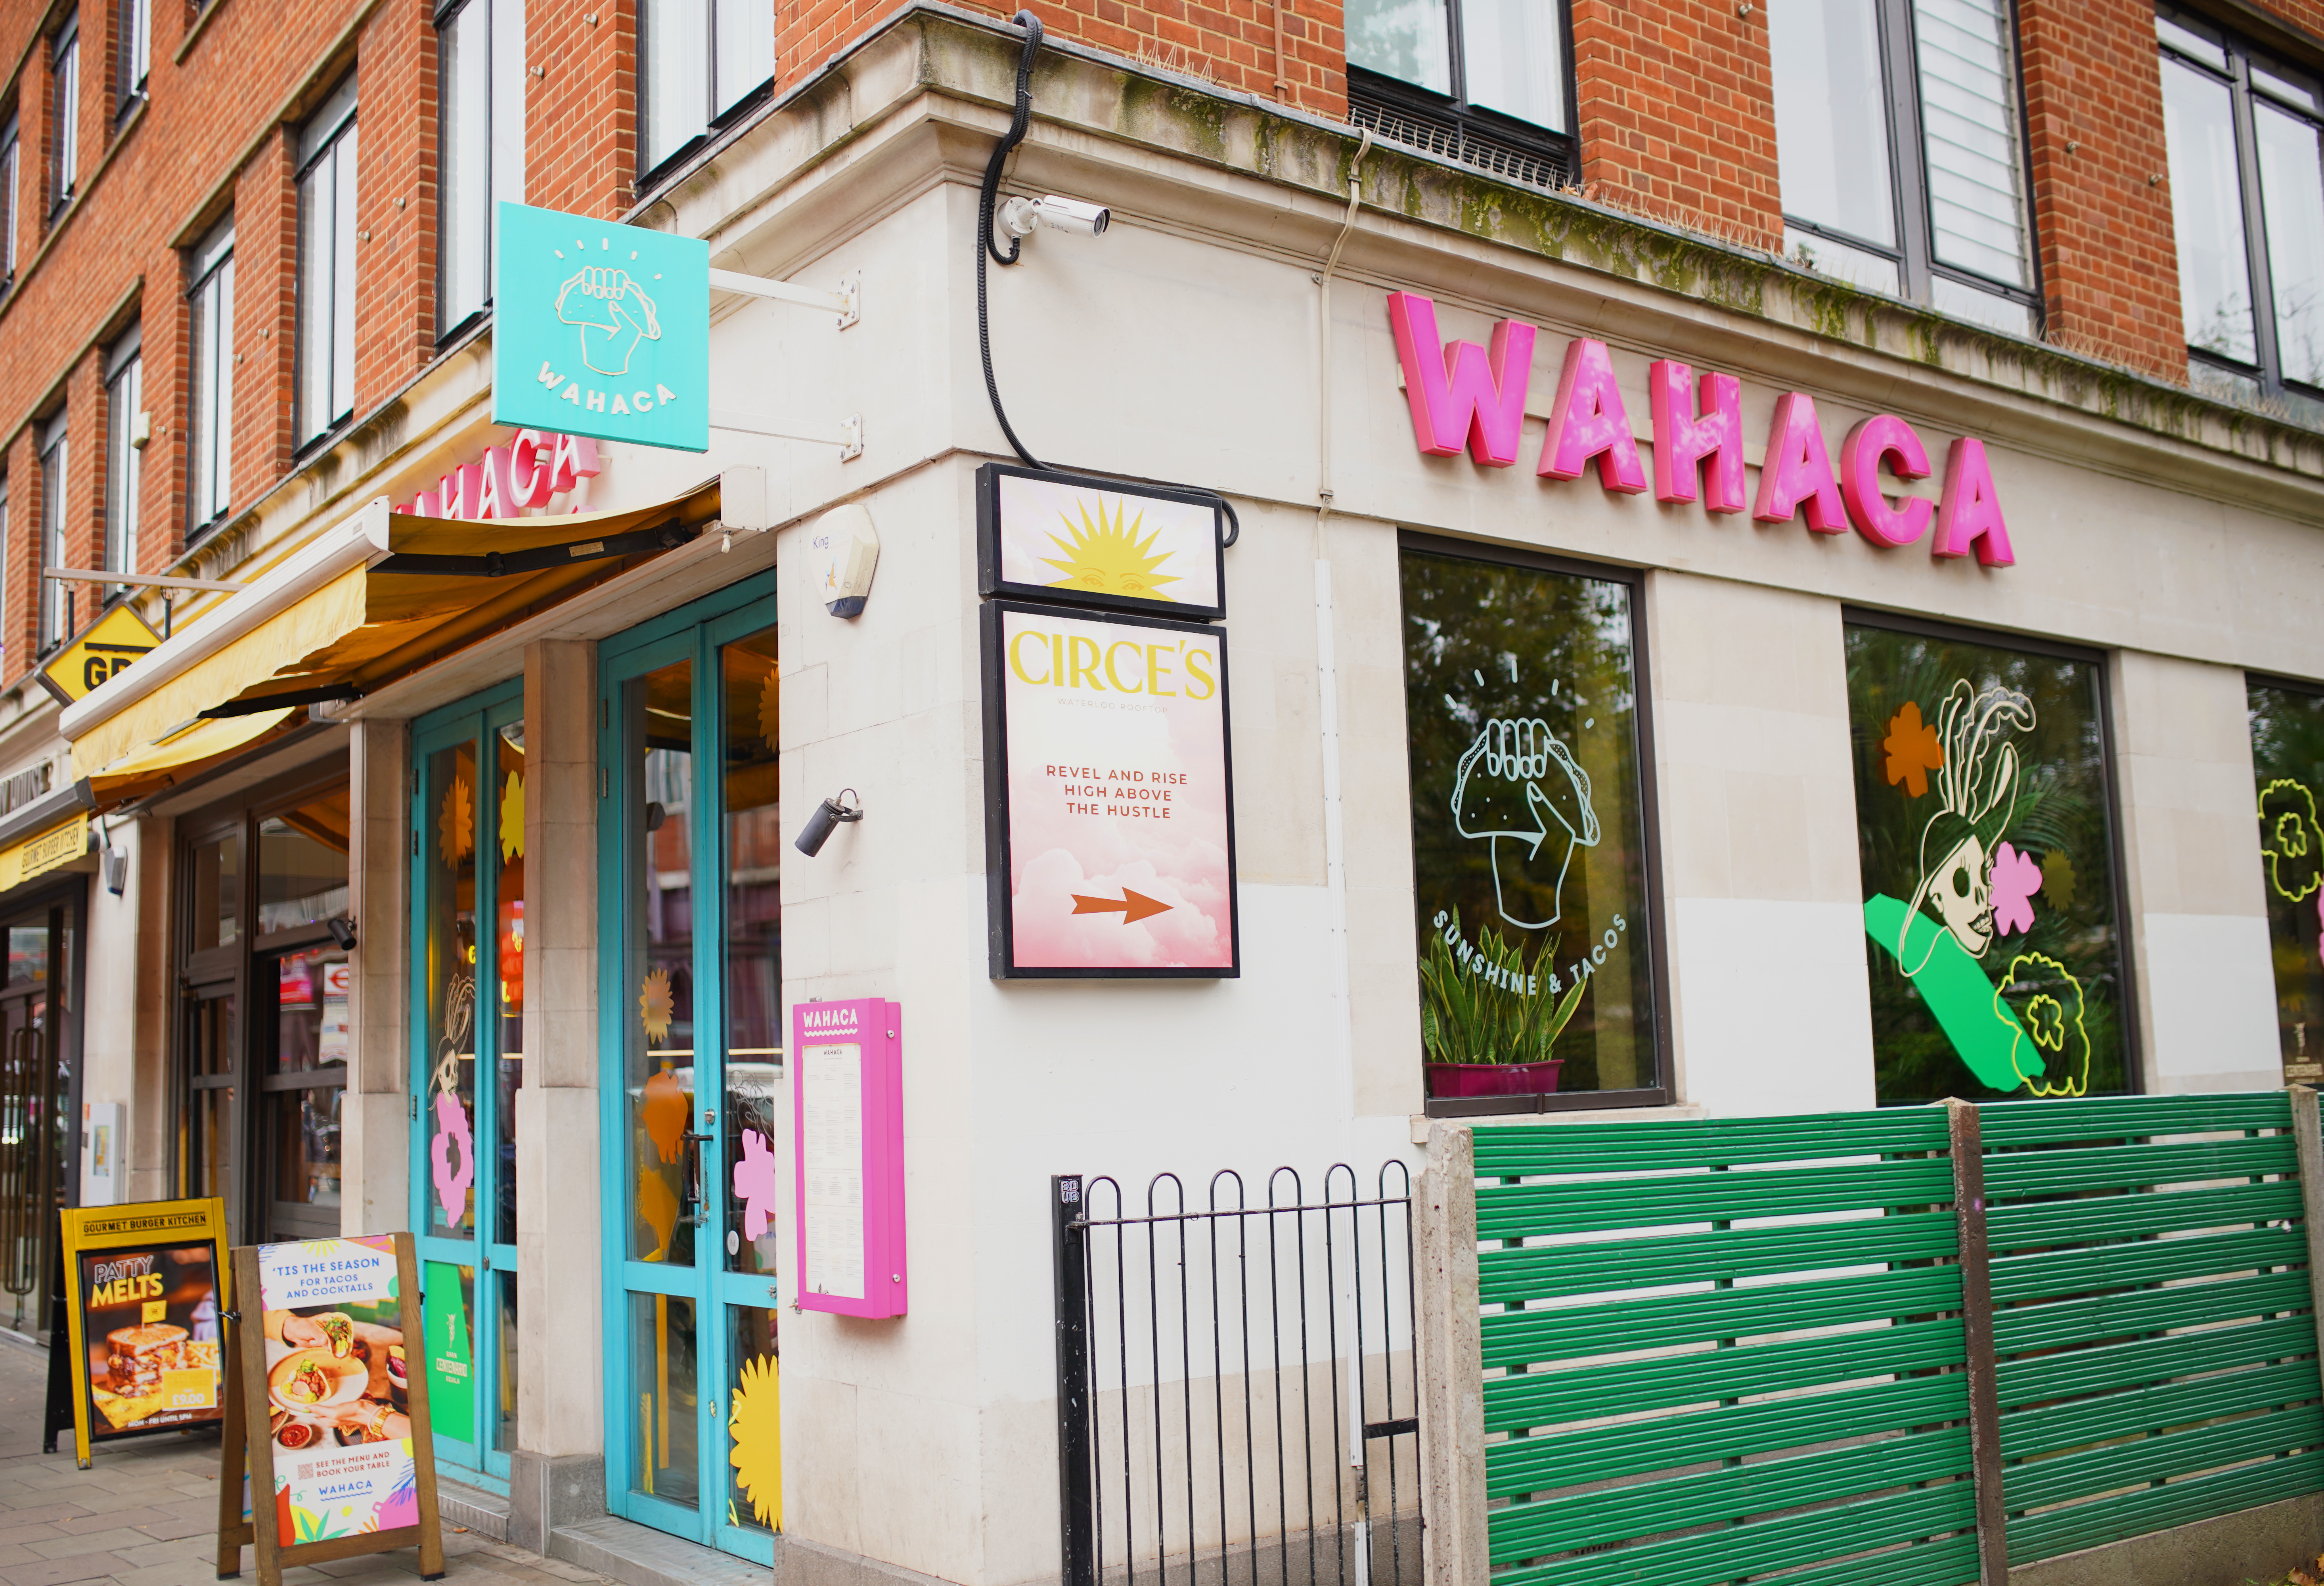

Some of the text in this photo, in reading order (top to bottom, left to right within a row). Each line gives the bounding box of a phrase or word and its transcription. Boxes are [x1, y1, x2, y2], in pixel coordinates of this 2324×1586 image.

[537, 360, 677, 415] WAHACA
[1387, 289, 2015, 569] WAHACA
[1010, 631, 1215, 700] CIRCE'S
[1058, 698, 1169, 714] WATERLOO ROOFTOP
[1047, 765, 1187, 785] REVEL AND RISE
[1065, 785, 1172, 801] HIGH ABOVE
[1066, 803, 1172, 820] THE HUSTLE
[1433, 909, 1627, 995] SUNSHINE & TACOS
[803, 1008, 858, 1028] WAHACA
[84, 1214, 206, 1233] GOURMET BURGER KITCHEN
[94, 1255, 154, 1284] PATTY
[302, 1263, 325, 1273] THE
[330, 1258, 379, 1271] SEASON
[301, 1274, 358, 1286] FOR TACOS
[91, 1272, 163, 1308] MELTS
[287, 1283, 373, 1299] AND COCKTAILS
[172, 1393, 205, 1406] £9.00
[128, 1419, 145, 1428] MON
[348, 1454, 370, 1463] MENU
[373, 1452, 390, 1460] AND
[317, 1461, 390, 1477] BOOK YOUR TABLE
[319, 1481, 372, 1495] WAHACA
